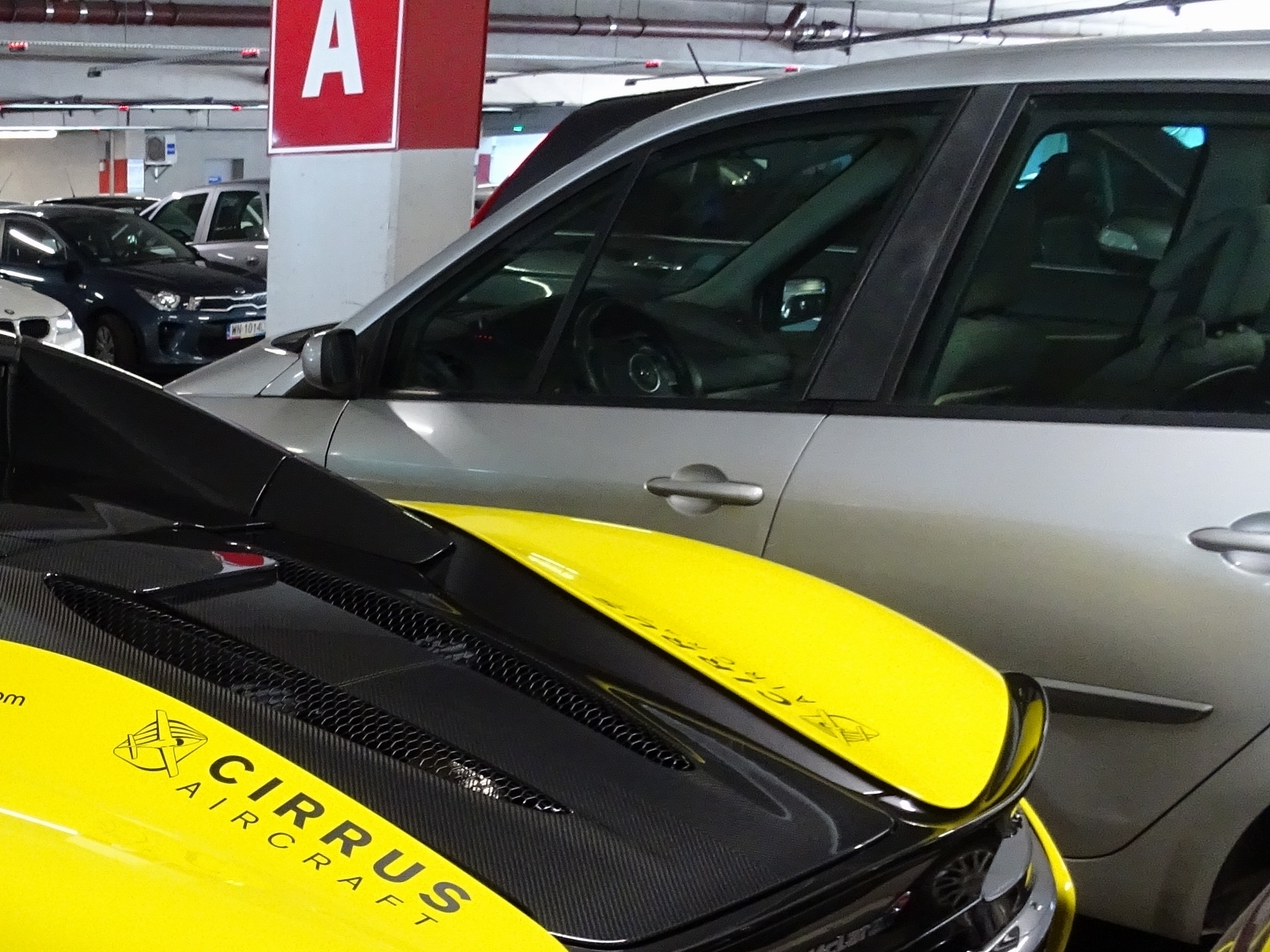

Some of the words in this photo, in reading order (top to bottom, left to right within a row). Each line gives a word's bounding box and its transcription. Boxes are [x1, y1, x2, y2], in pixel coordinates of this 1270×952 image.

[301, 0, 364, 98] A
[176, 782, 438, 926] AIRCRAFT
[209, 755, 471, 914] CIRRUS
